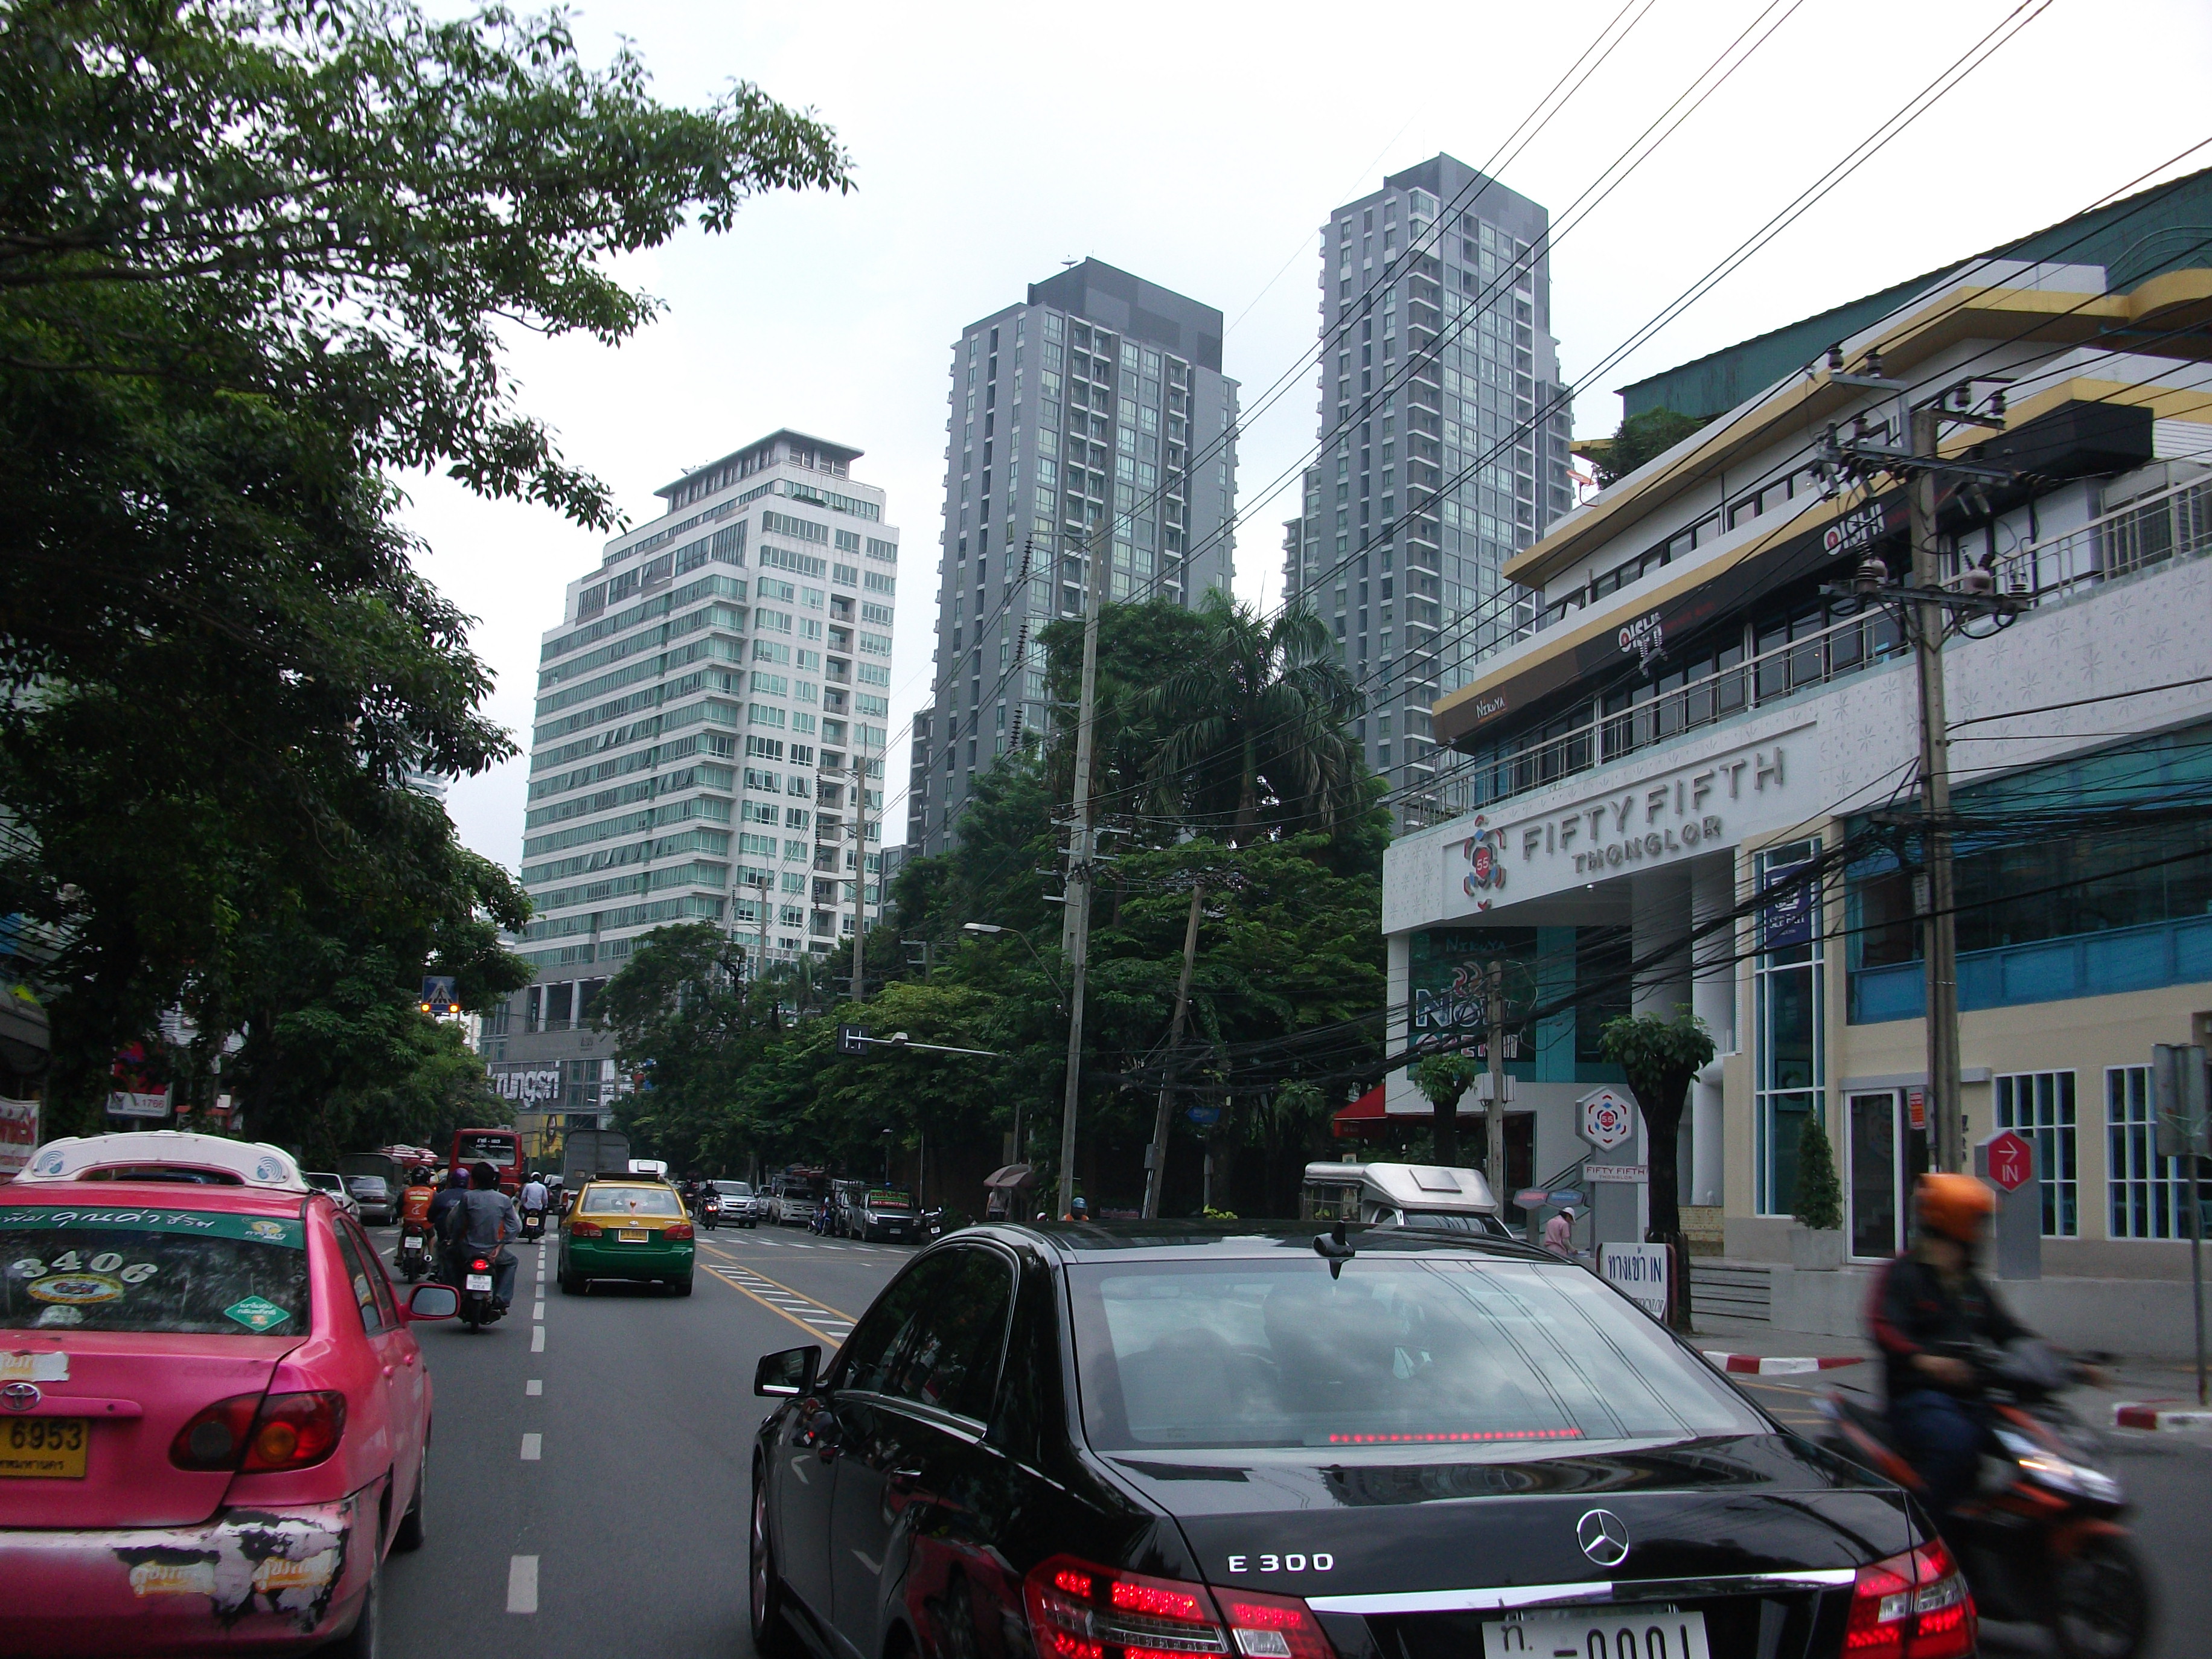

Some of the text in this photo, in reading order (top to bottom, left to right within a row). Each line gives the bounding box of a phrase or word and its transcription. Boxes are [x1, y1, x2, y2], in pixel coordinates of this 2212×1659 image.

[1823, 503, 1884, 555] OISHI
[1523, 746, 1783, 860] FIFTY FIFTH
[1571, 815, 1721, 874] THONGLOR
[1477, 857, 1489, 871] 55
[2002, 1165, 2018, 1182] IN
[12, 1250, 158, 1283] 3406
[1608, 1246, 1661, 1282] ทางเข้า IN
[11, 1420, 82, 1450] 6953
[1228, 1553, 1334, 1572] E 300
